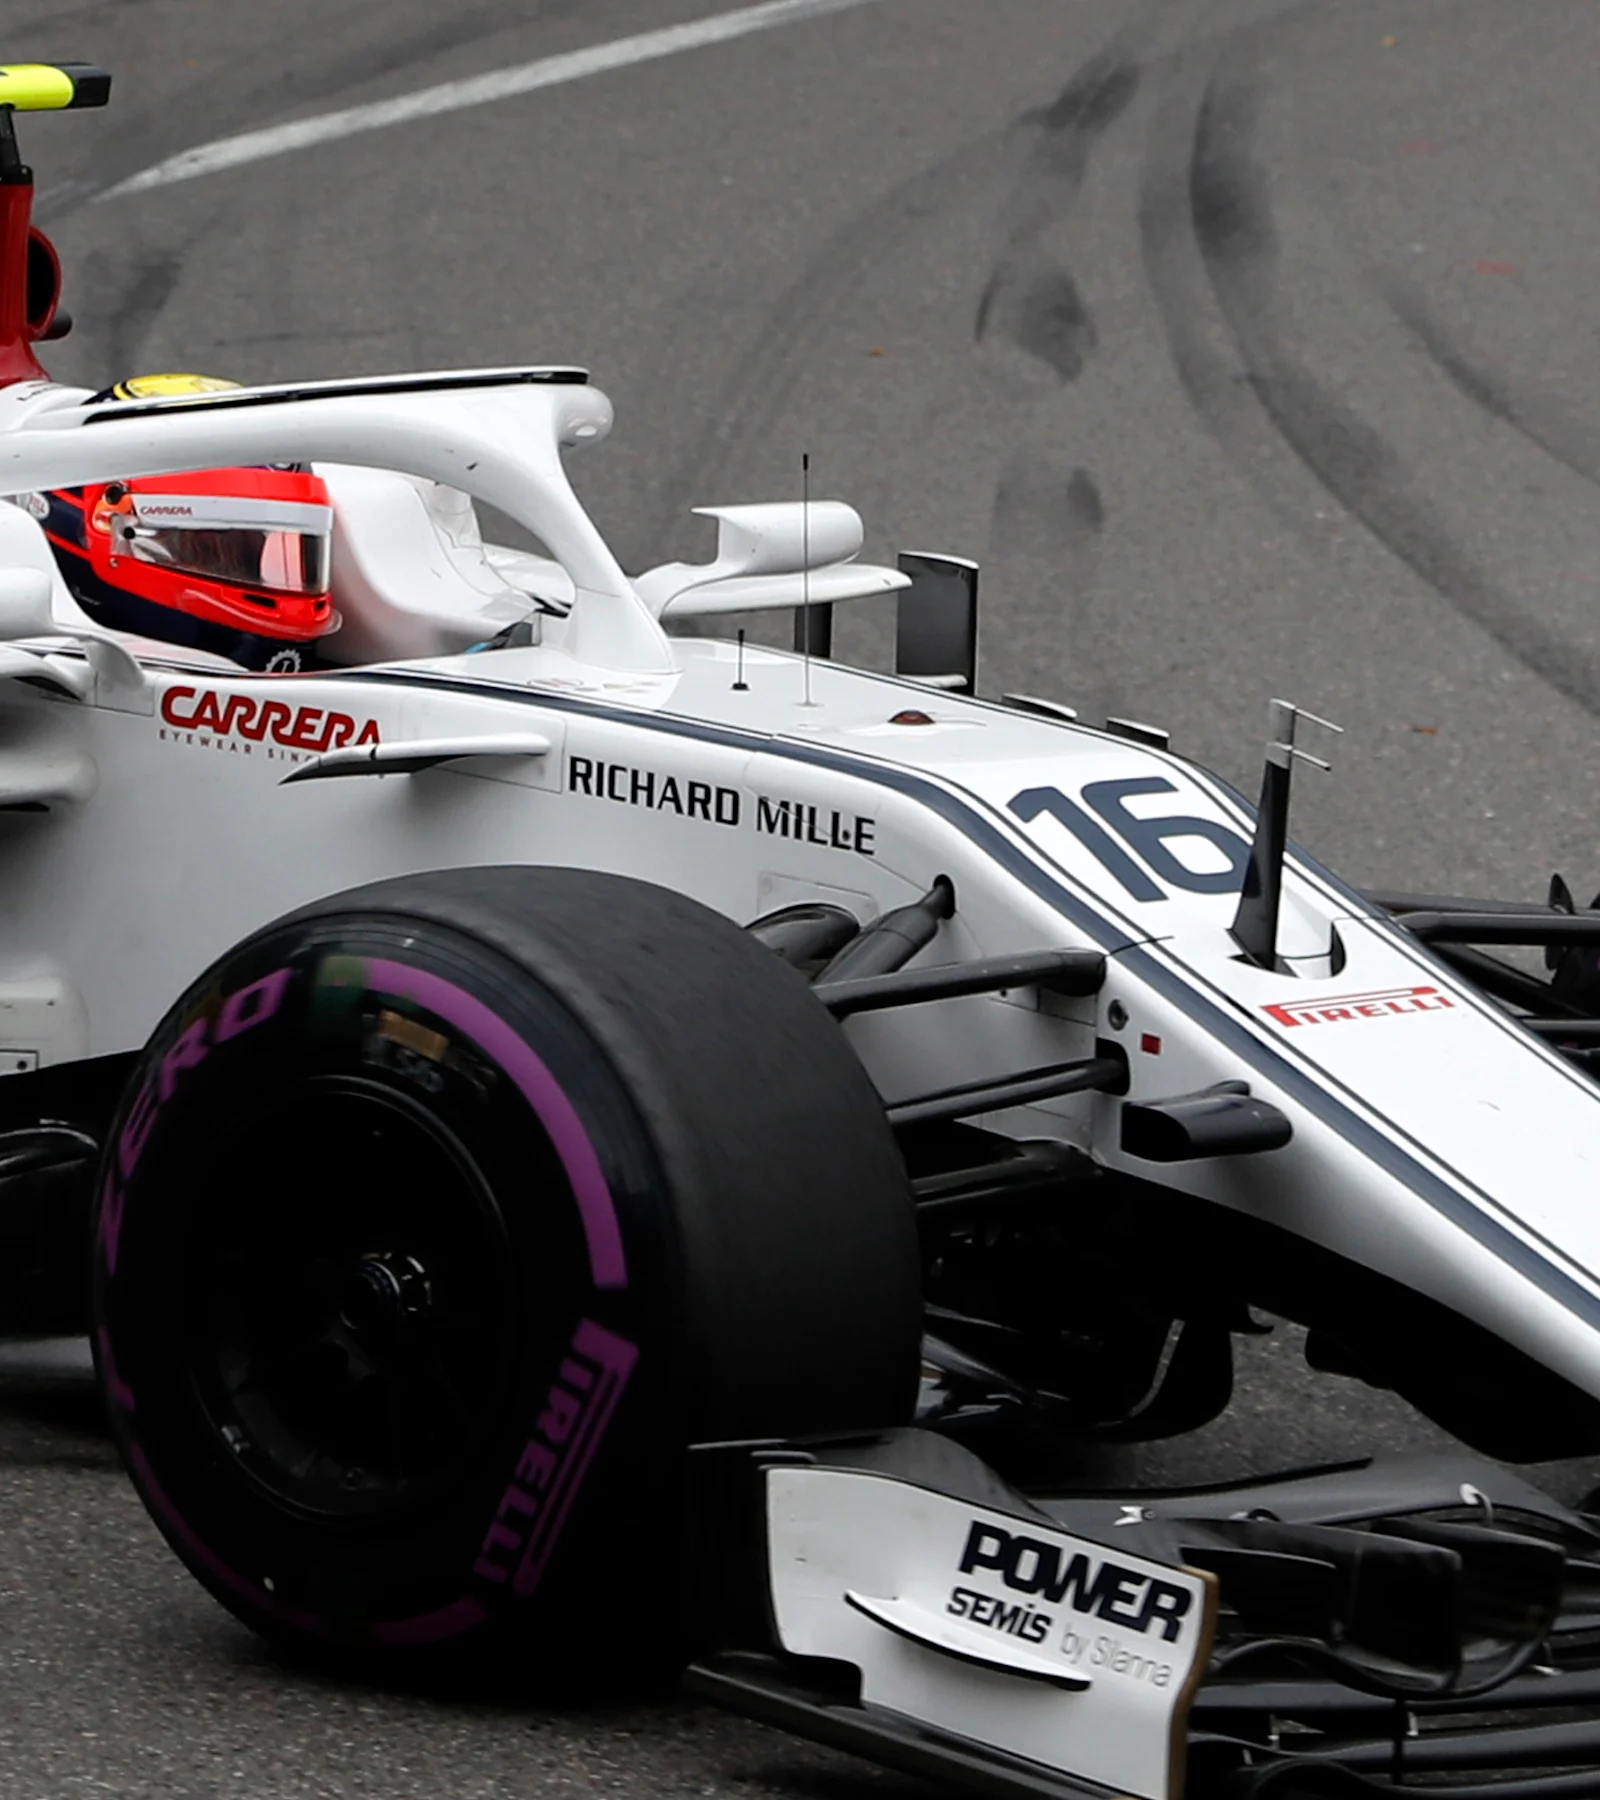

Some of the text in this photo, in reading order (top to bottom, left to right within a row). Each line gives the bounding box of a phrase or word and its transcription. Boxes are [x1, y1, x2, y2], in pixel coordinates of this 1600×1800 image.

[139, 505, 193, 517] CARRERA
[159, 729, 252, 756] EYEWEAR
[160, 686, 382, 753] CARRERA
[568, 755, 876, 857] RICHARD MILLE
[1006, 776, 1252, 902] 16
[1261, 986, 1456, 1027] PIRELLI
[470, 1315, 641, 1600] PIRELLI
[959, 1520, 1191, 1643] POWER
